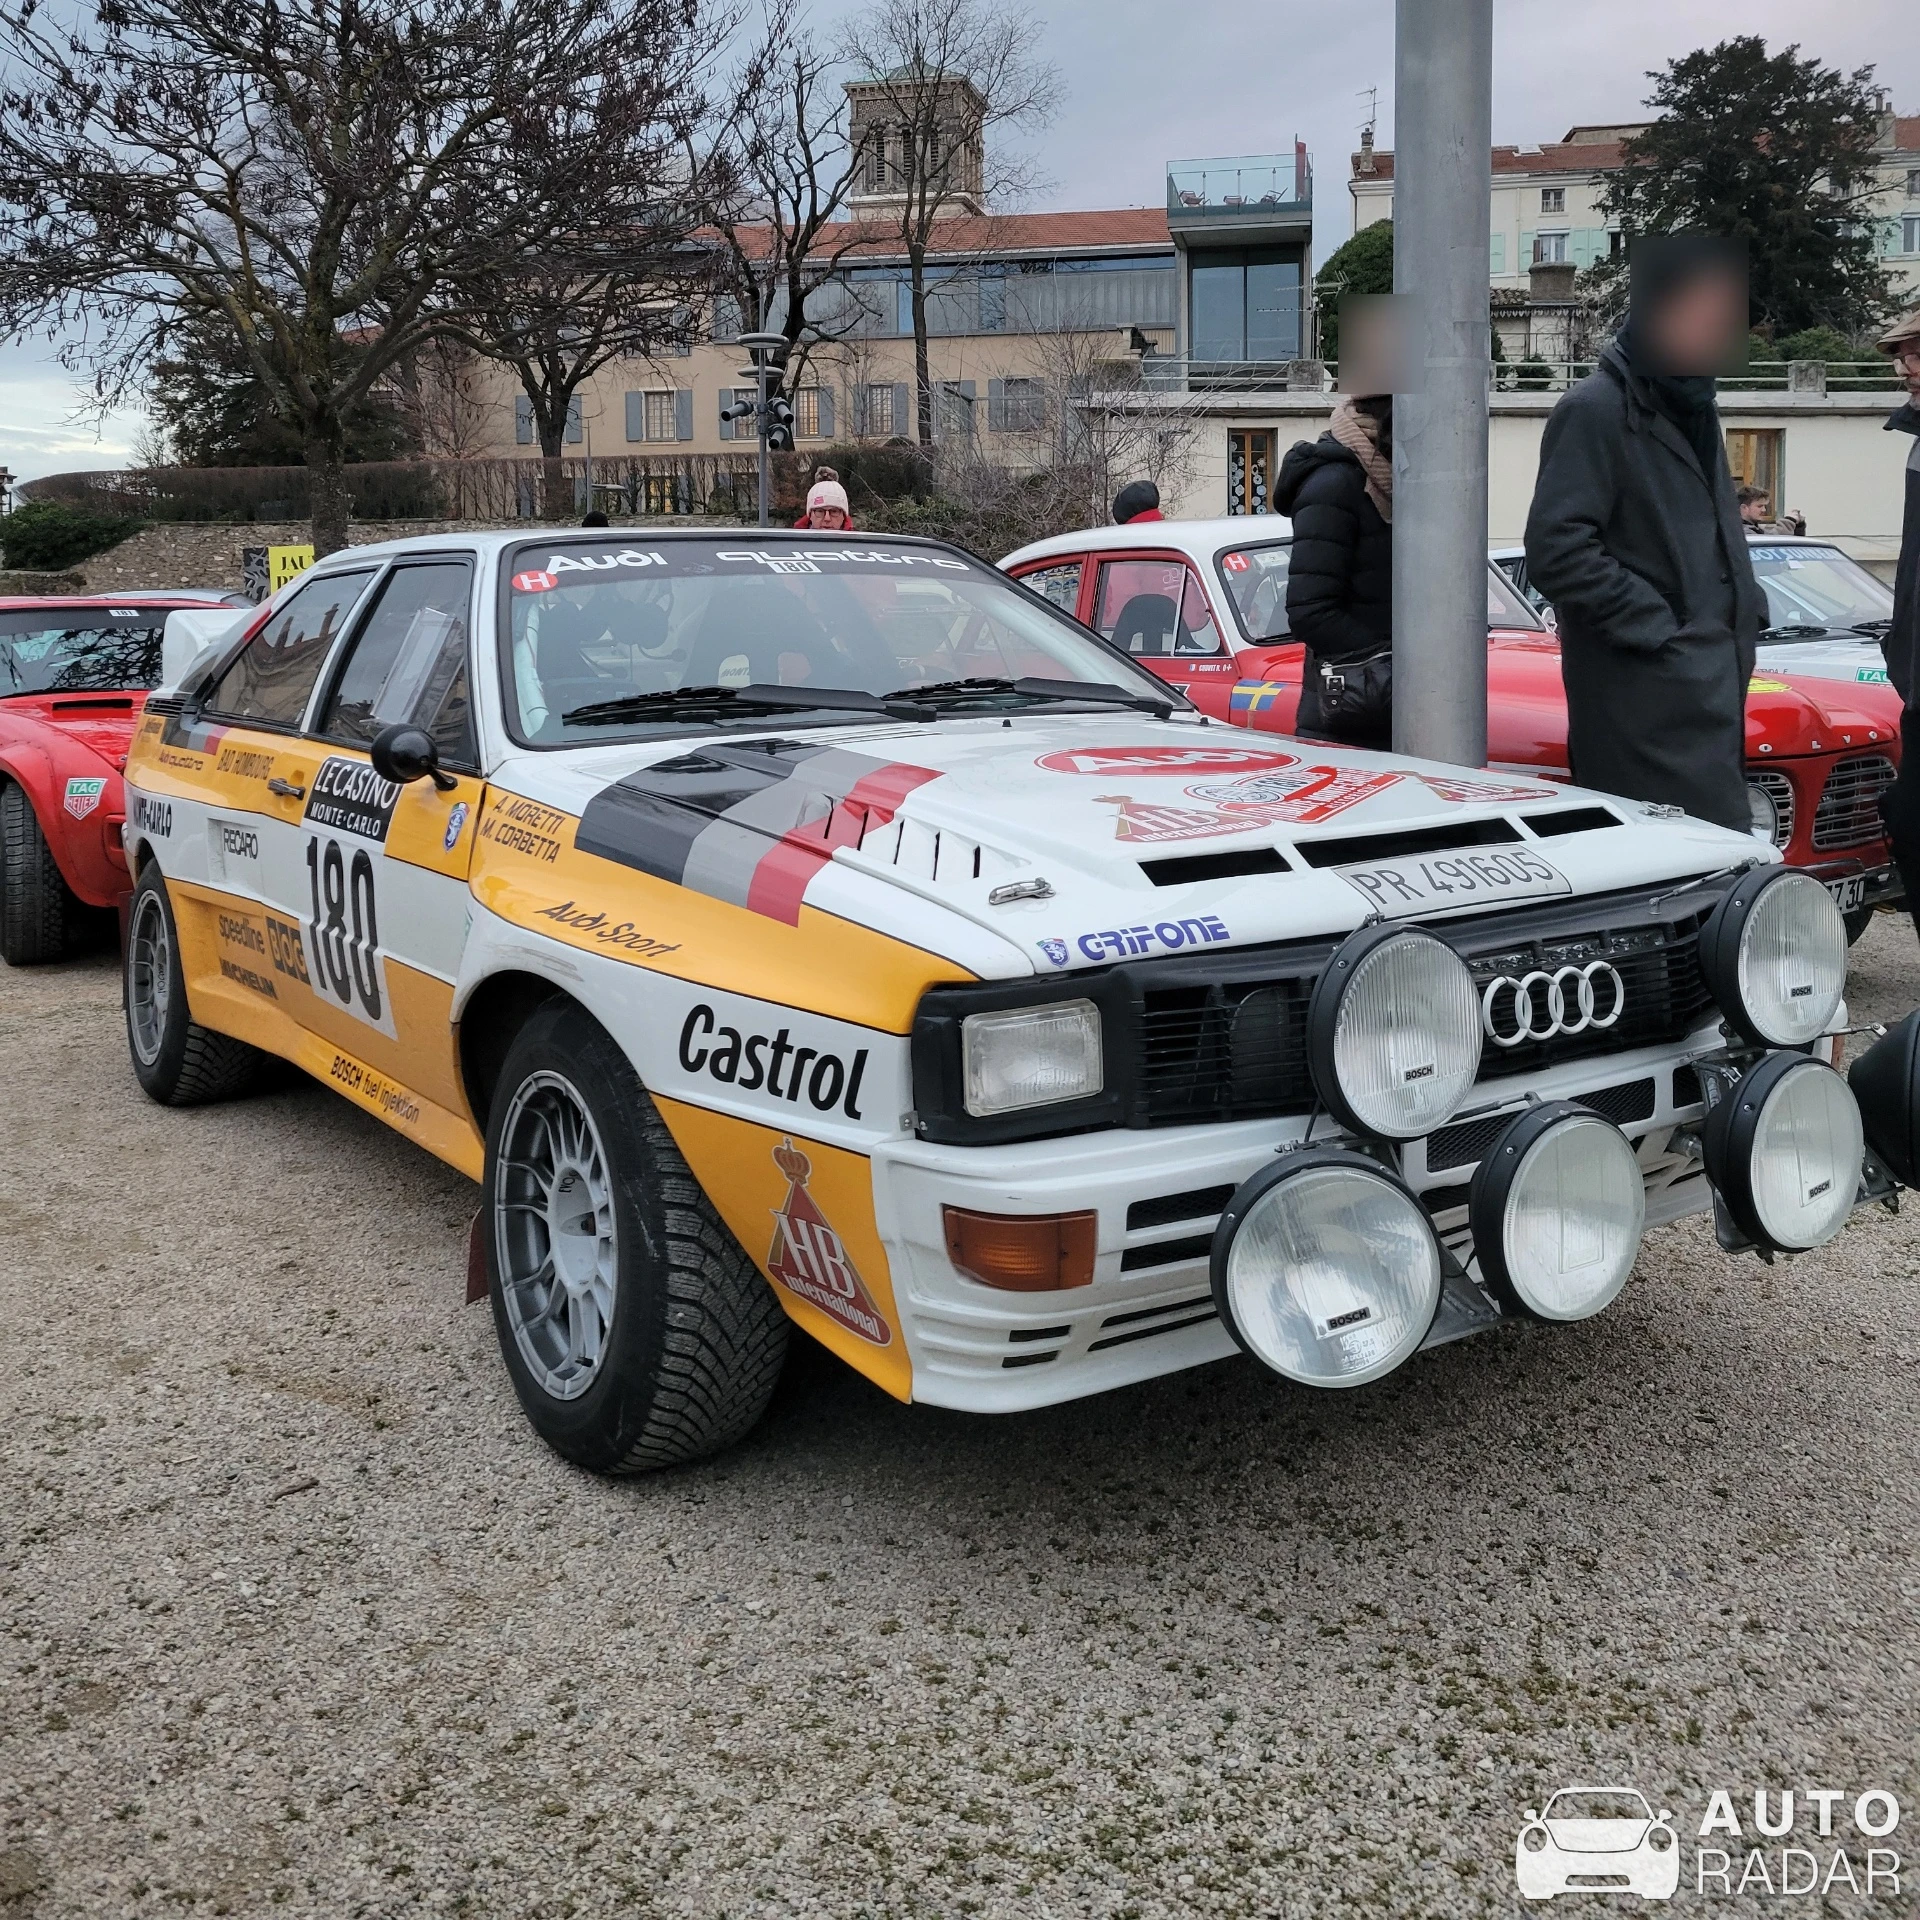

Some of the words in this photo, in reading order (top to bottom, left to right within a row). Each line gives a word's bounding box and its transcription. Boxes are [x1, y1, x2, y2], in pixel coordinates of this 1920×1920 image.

[546, 549, 669, 574] Audi
[716, 549, 970, 571] quattro
[774, 561, 814, 573] 180
[1227, 554, 1248, 571] H
[520, 572, 551, 590] H
[1758, 730, 1878, 752] OLVO
[1065, 750, 1278, 773] Audi
[71, 782, 99, 795] TAG
[314, 760, 341, 793] LE
[332, 764, 400, 809] CASINO
[68, 795, 96, 814] HEUER
[493, 796, 508, 815] A.
[505, 799, 566, 835] MORETTI
[1112, 807, 1220, 832] HB
[223, 827, 259, 861] RECARO
[480, 817, 493, 840] M.
[495, 822, 561, 864] CORBETTA
[1350, 869, 1425, 905] PR
[1419, 851, 1554, 894] 491605
[218, 913, 266, 955] speedline
[306, 835, 382, 1021] 180
[534, 901, 608, 932] Audi
[596, 922, 683, 958] Sport
[218, 956, 279, 1000] MICHELIN
[1791, 986, 1812, 997] BOSCH
[679, 1004, 869, 1121] Castrol
[1405, 1065, 1433, 1081] BOSCH
[330, 1055, 364, 1090] BOSCH
[361, 1073, 382, 1100] fuel
[379, 1082, 420, 1125] injektion
[1808, 1179, 1830, 1198] BOSCH
[773, 1211, 856, 1300] HB
[1329, 1308, 1368, 1329] BOSCH
